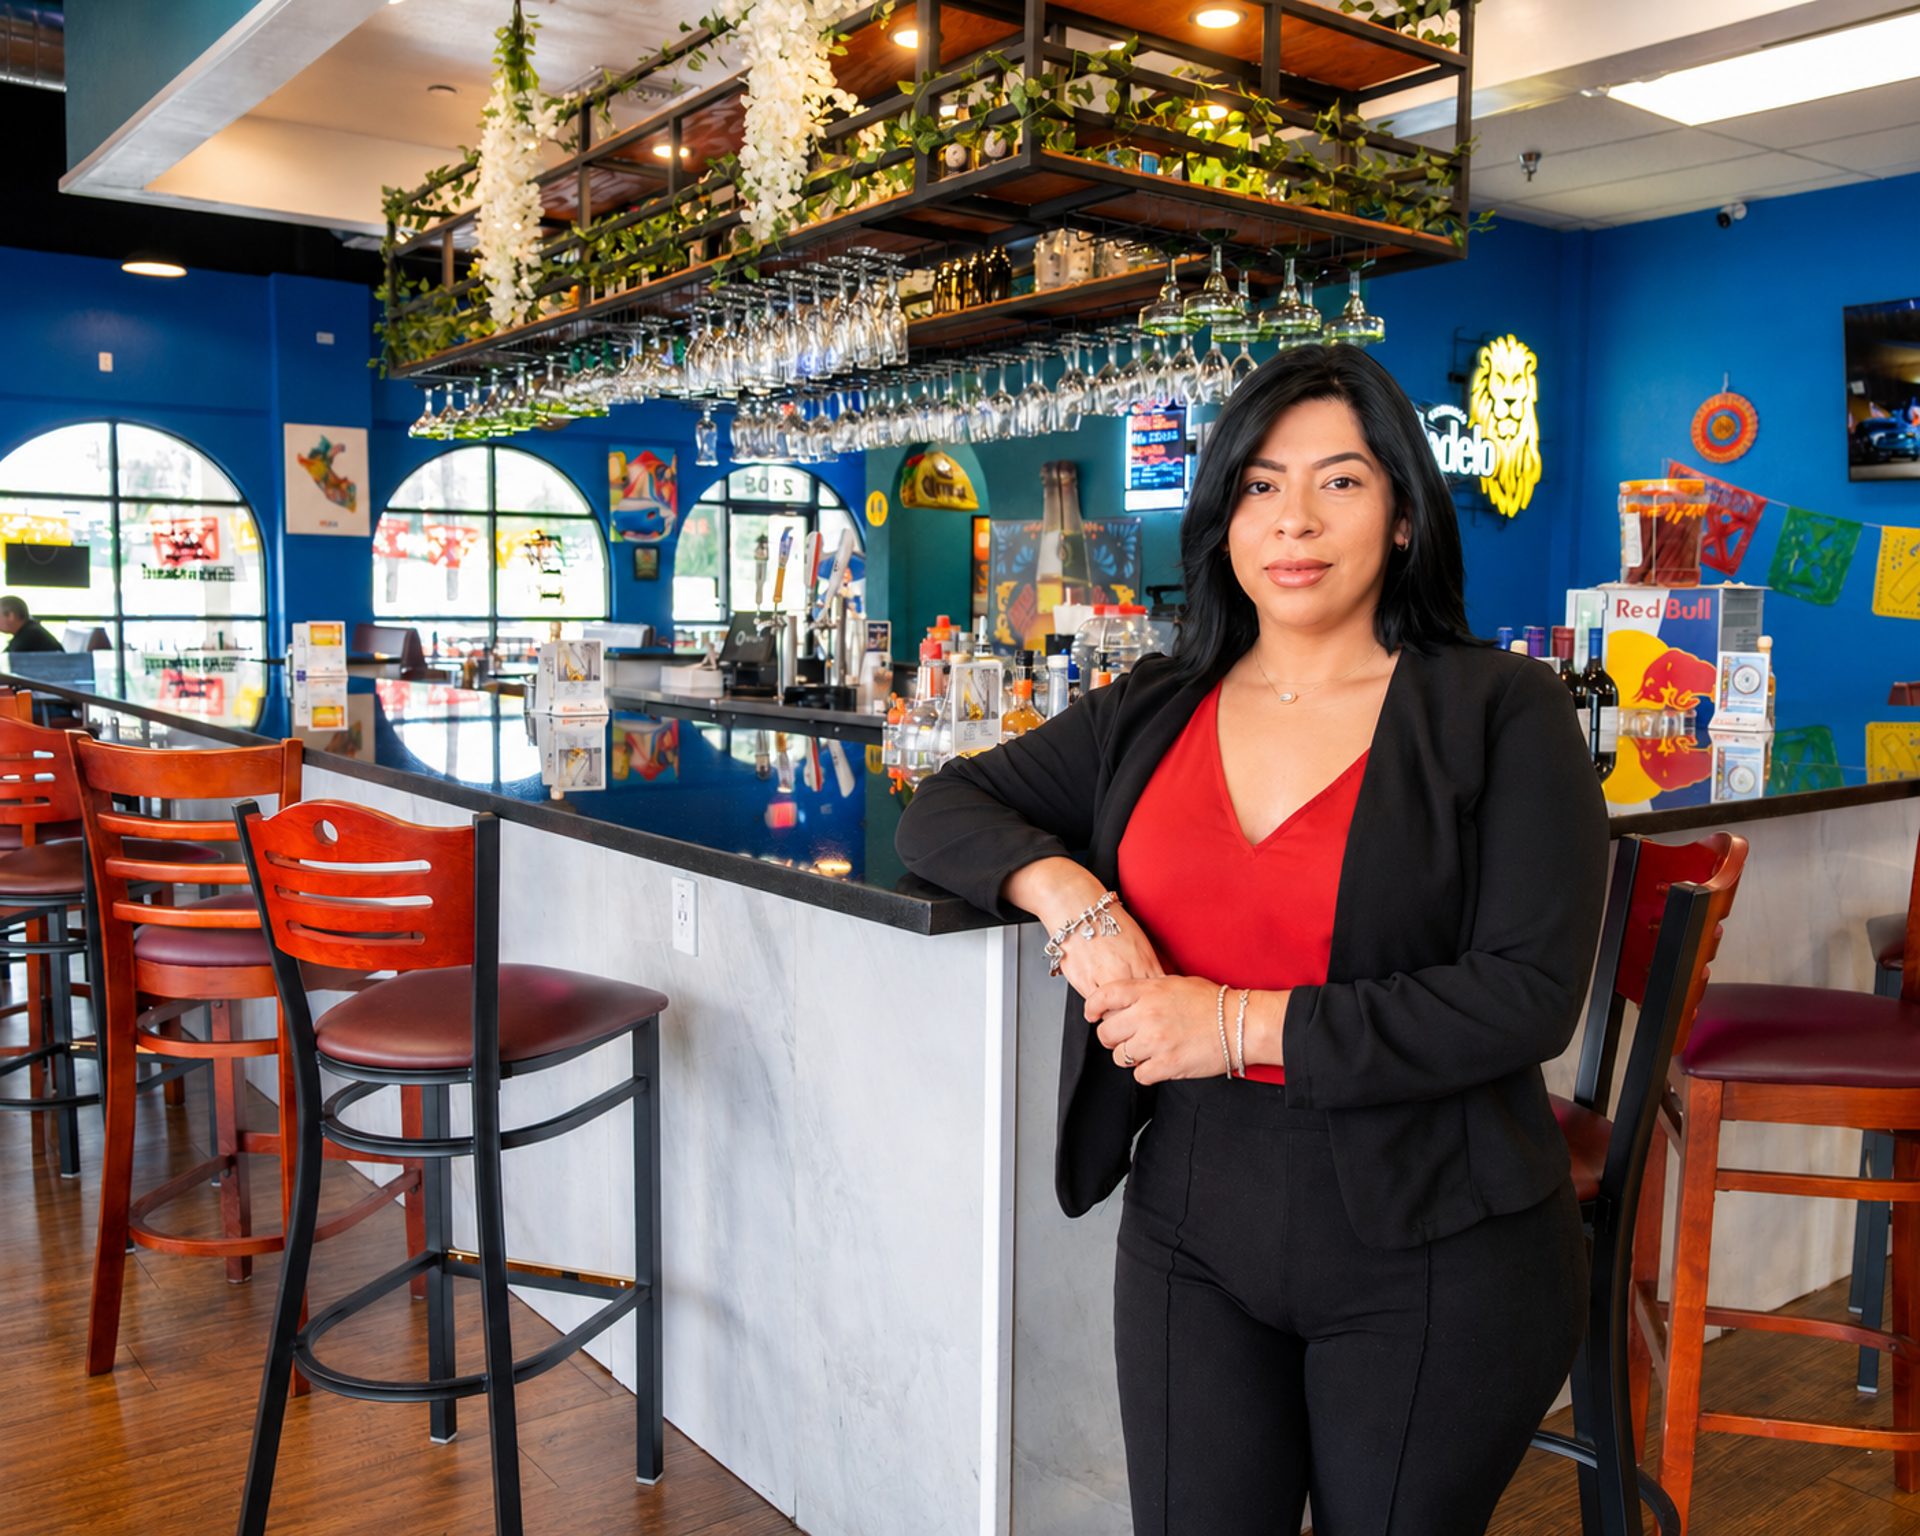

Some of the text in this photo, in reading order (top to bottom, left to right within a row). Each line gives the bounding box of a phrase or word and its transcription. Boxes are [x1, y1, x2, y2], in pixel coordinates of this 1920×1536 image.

[1418, 413, 1497, 476] odelo
[1616, 598, 1711, 620] Red Bull
